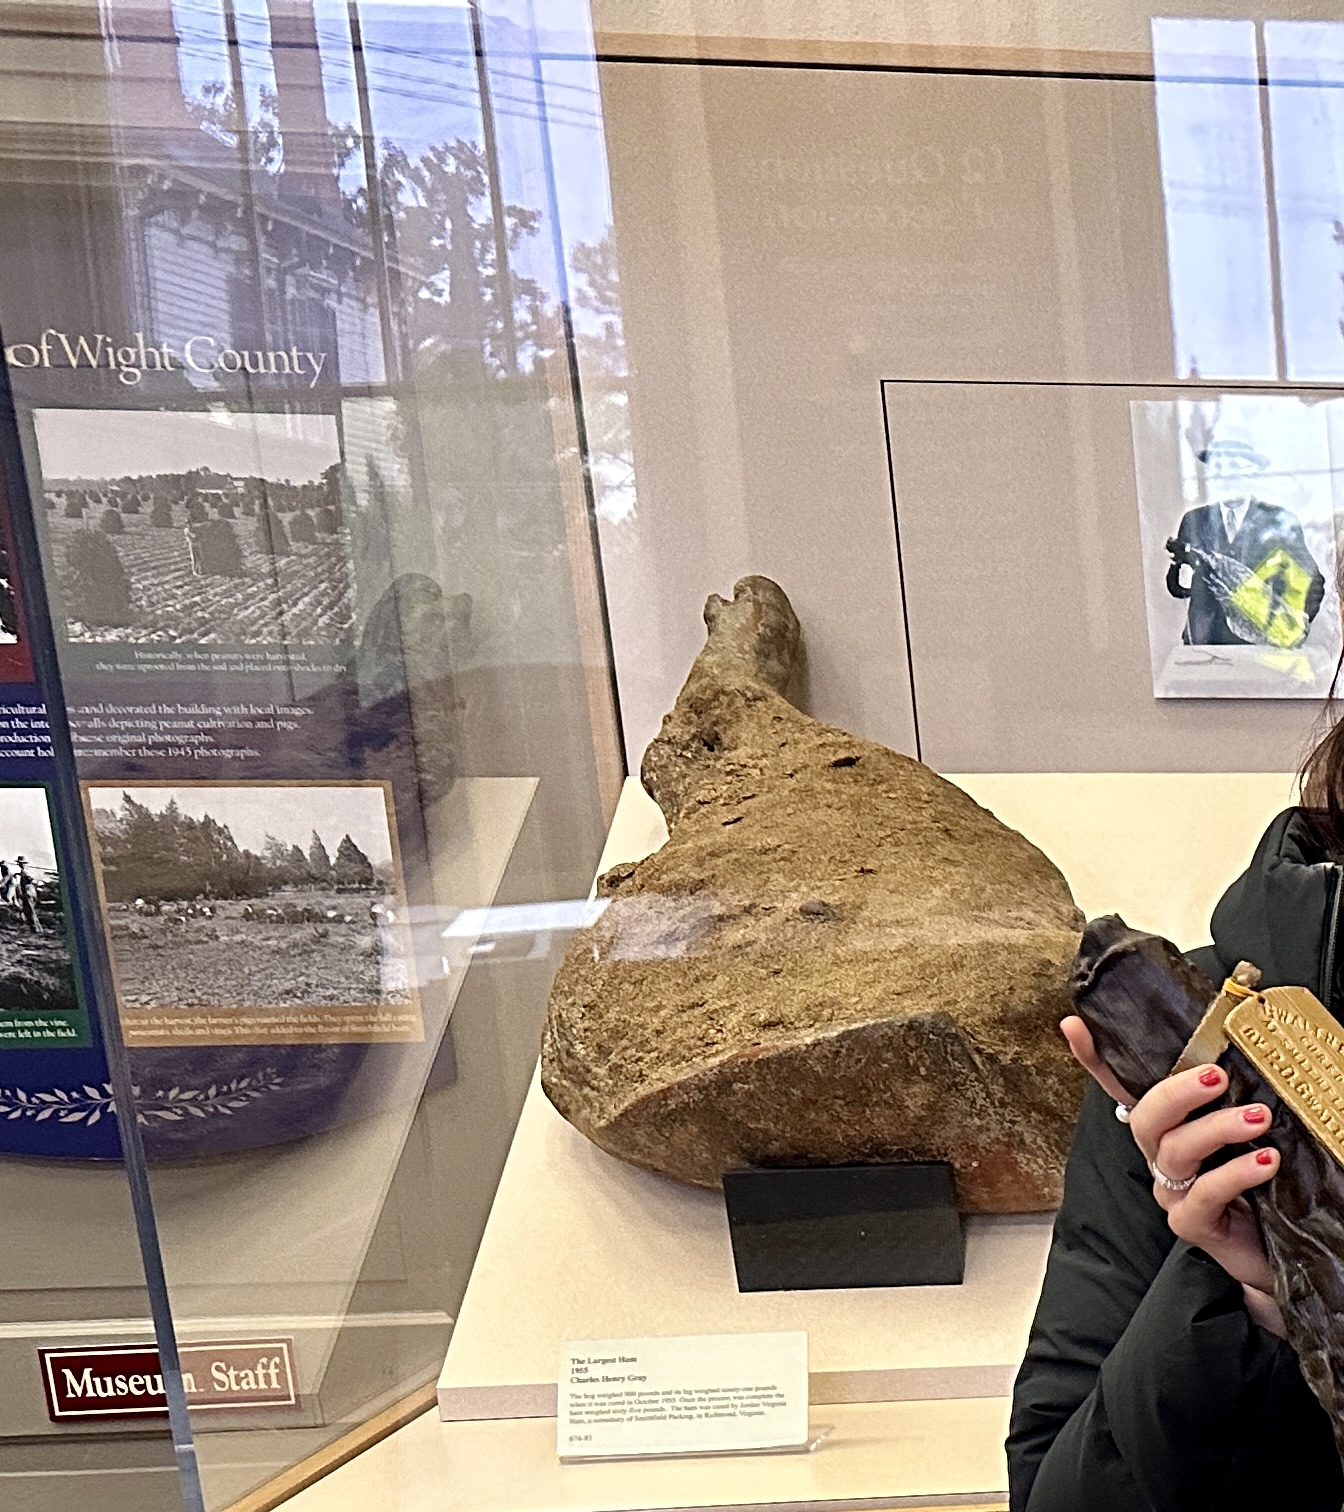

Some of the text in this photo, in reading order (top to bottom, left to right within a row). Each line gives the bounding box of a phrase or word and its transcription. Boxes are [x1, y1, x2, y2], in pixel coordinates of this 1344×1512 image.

[6, 328, 327, 388] of Wight County
[210, 1356, 281, 1392] Staff
